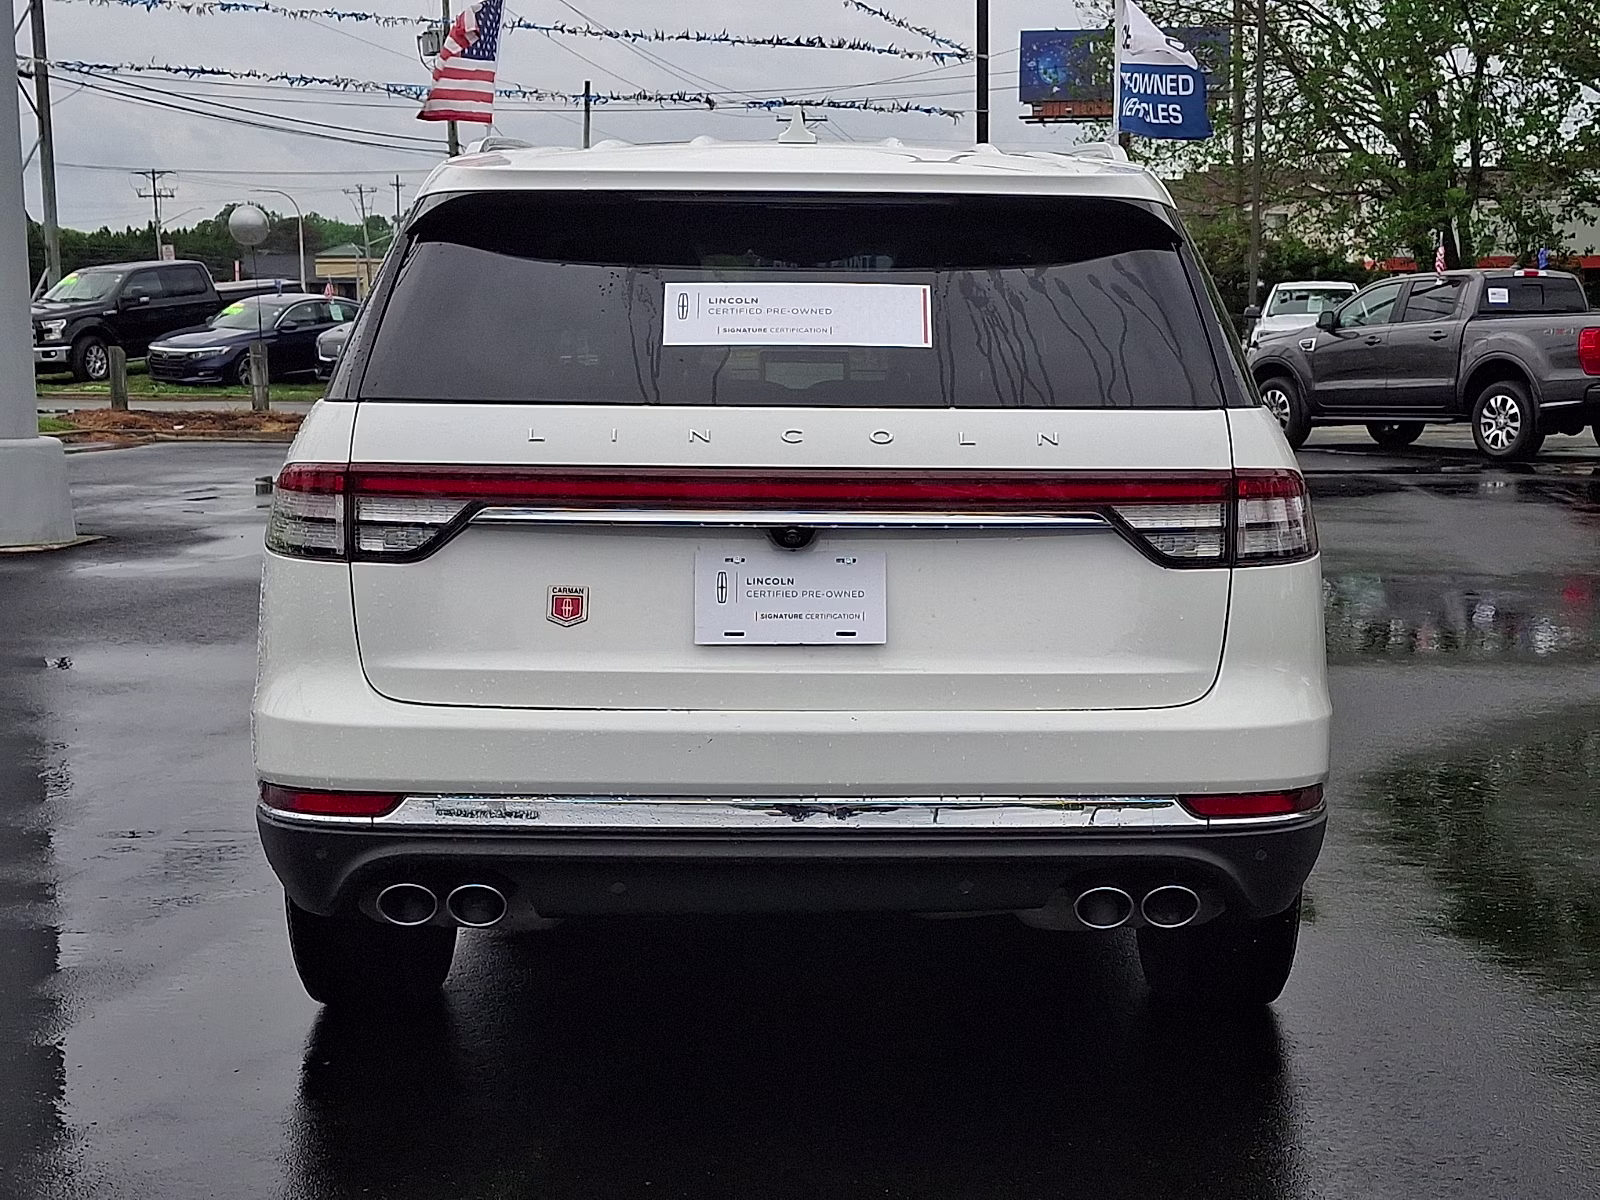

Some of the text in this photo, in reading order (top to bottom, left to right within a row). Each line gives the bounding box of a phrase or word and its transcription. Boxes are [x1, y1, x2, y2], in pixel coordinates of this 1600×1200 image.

[708, 297, 760, 305] LINCOLN
[707, 307, 833, 315] CERTIFIED PRE-OWNED
[527, 427, 1060, 447] LINCOLN
[745, 577, 795, 586] LINCOLN
[745, 590, 865, 598] CERTIFIED PRE-OWNED
